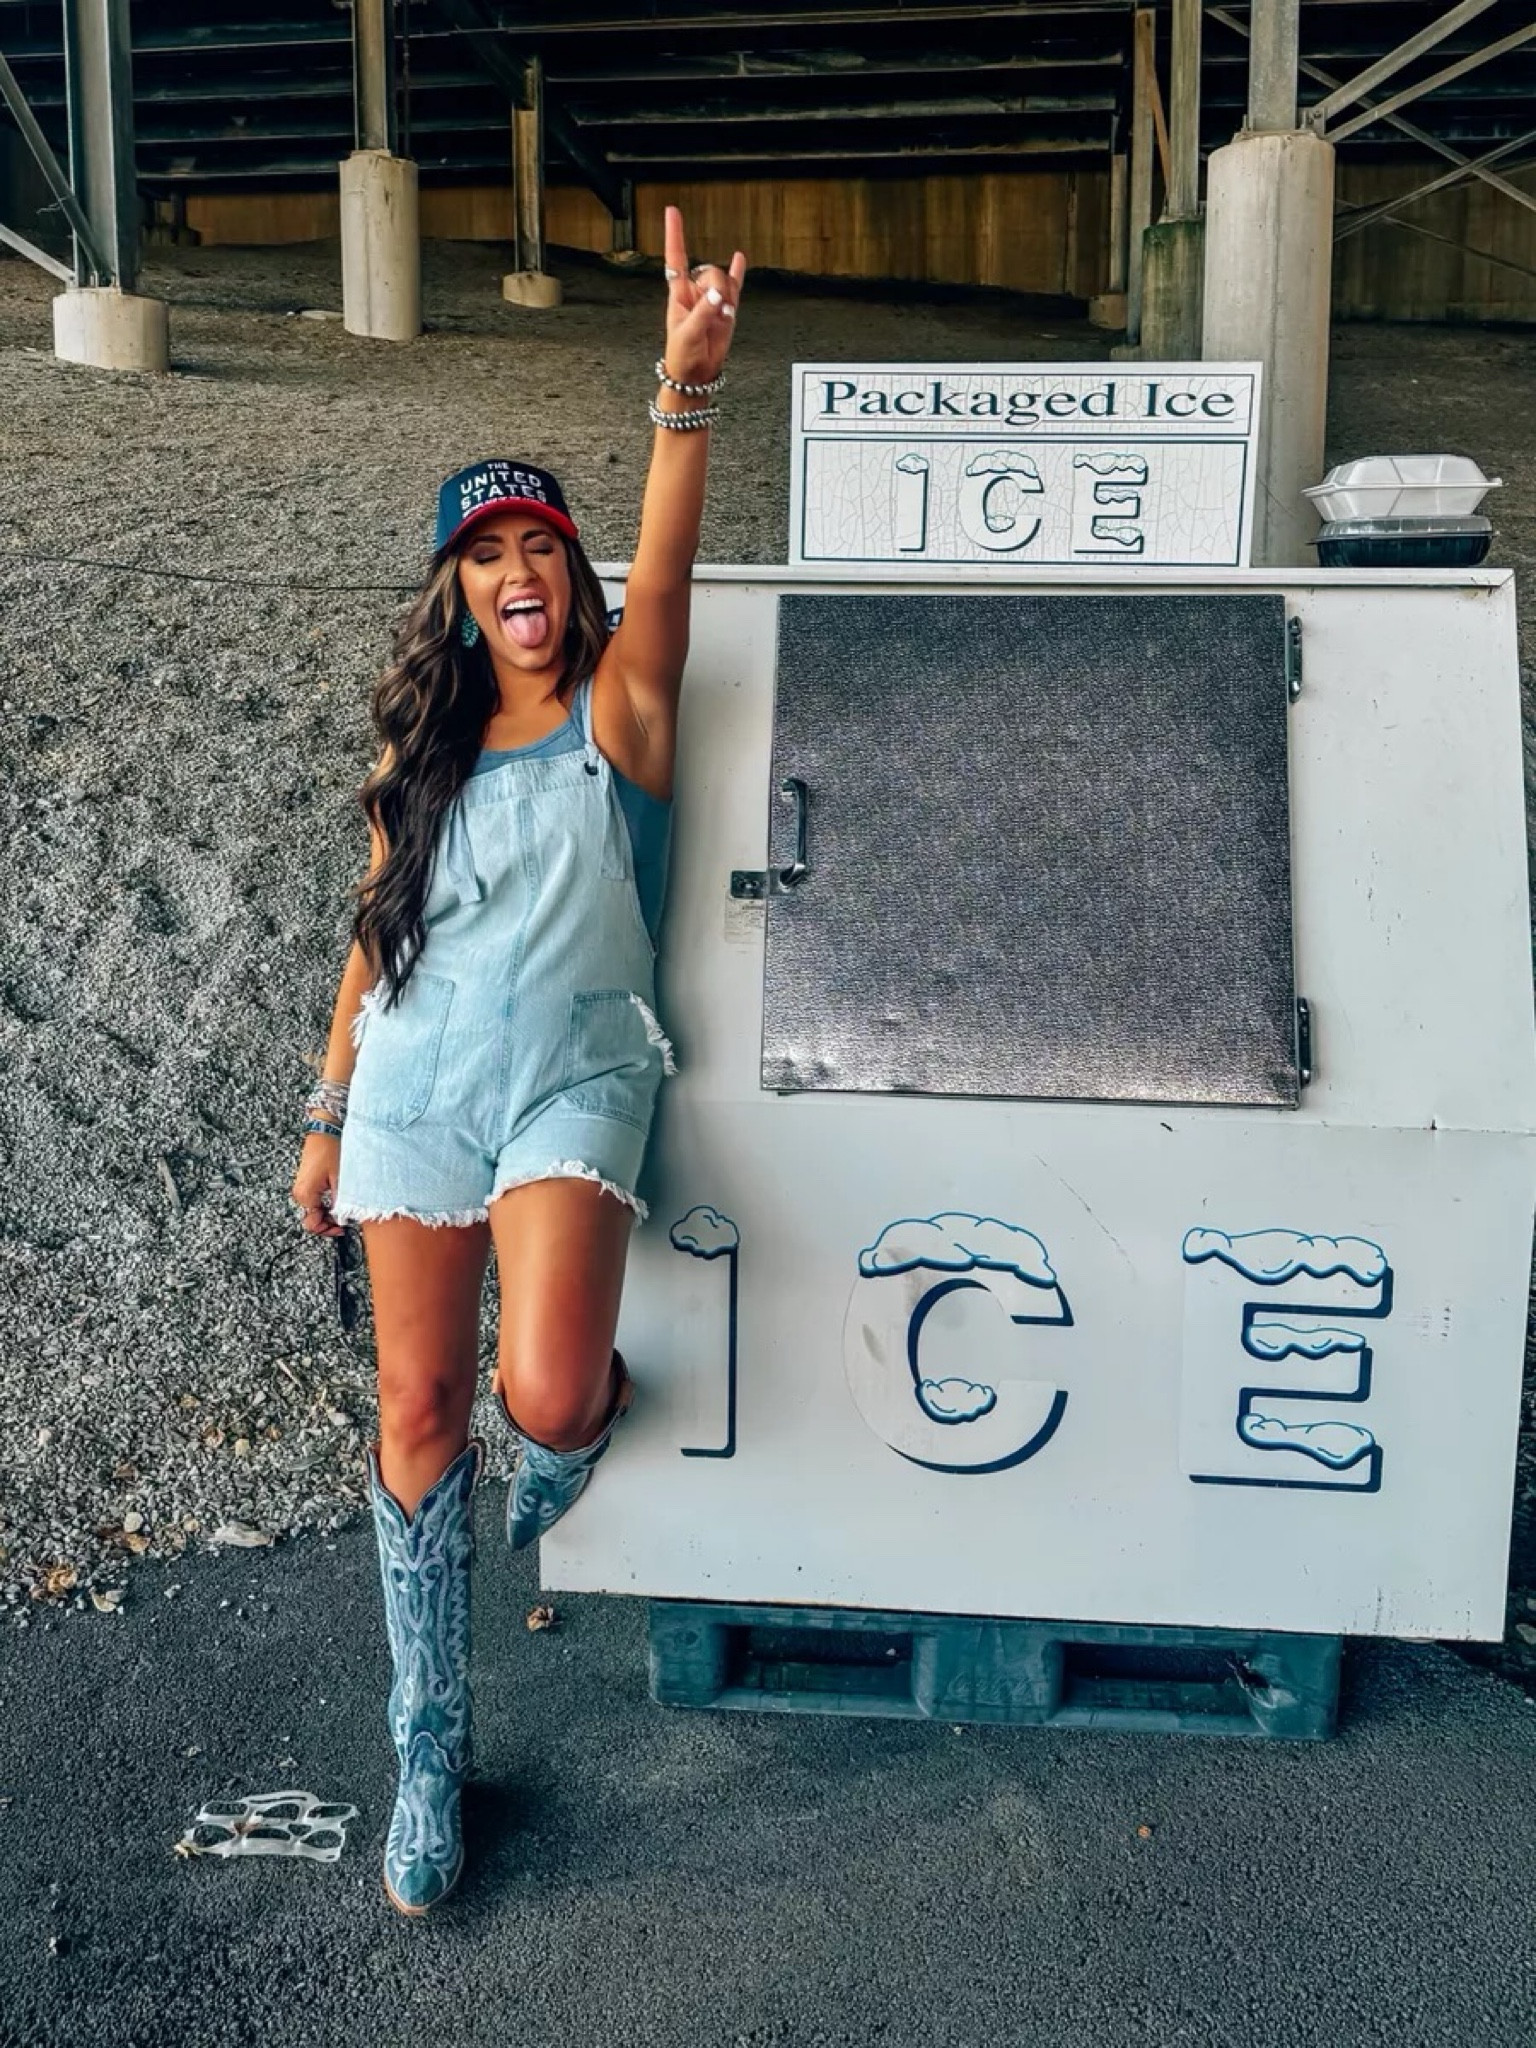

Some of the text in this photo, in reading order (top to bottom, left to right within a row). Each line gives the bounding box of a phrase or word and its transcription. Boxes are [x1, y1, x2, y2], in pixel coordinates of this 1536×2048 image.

[821, 380, 1235, 427] Packaged Ice
[460, 470, 542, 494] UNITED
[487, 462, 510, 470] THE
[460, 484, 547, 511] STATES
[896, 450, 1149, 554] ICE
[669, 1205, 1393, 1493] ICE
